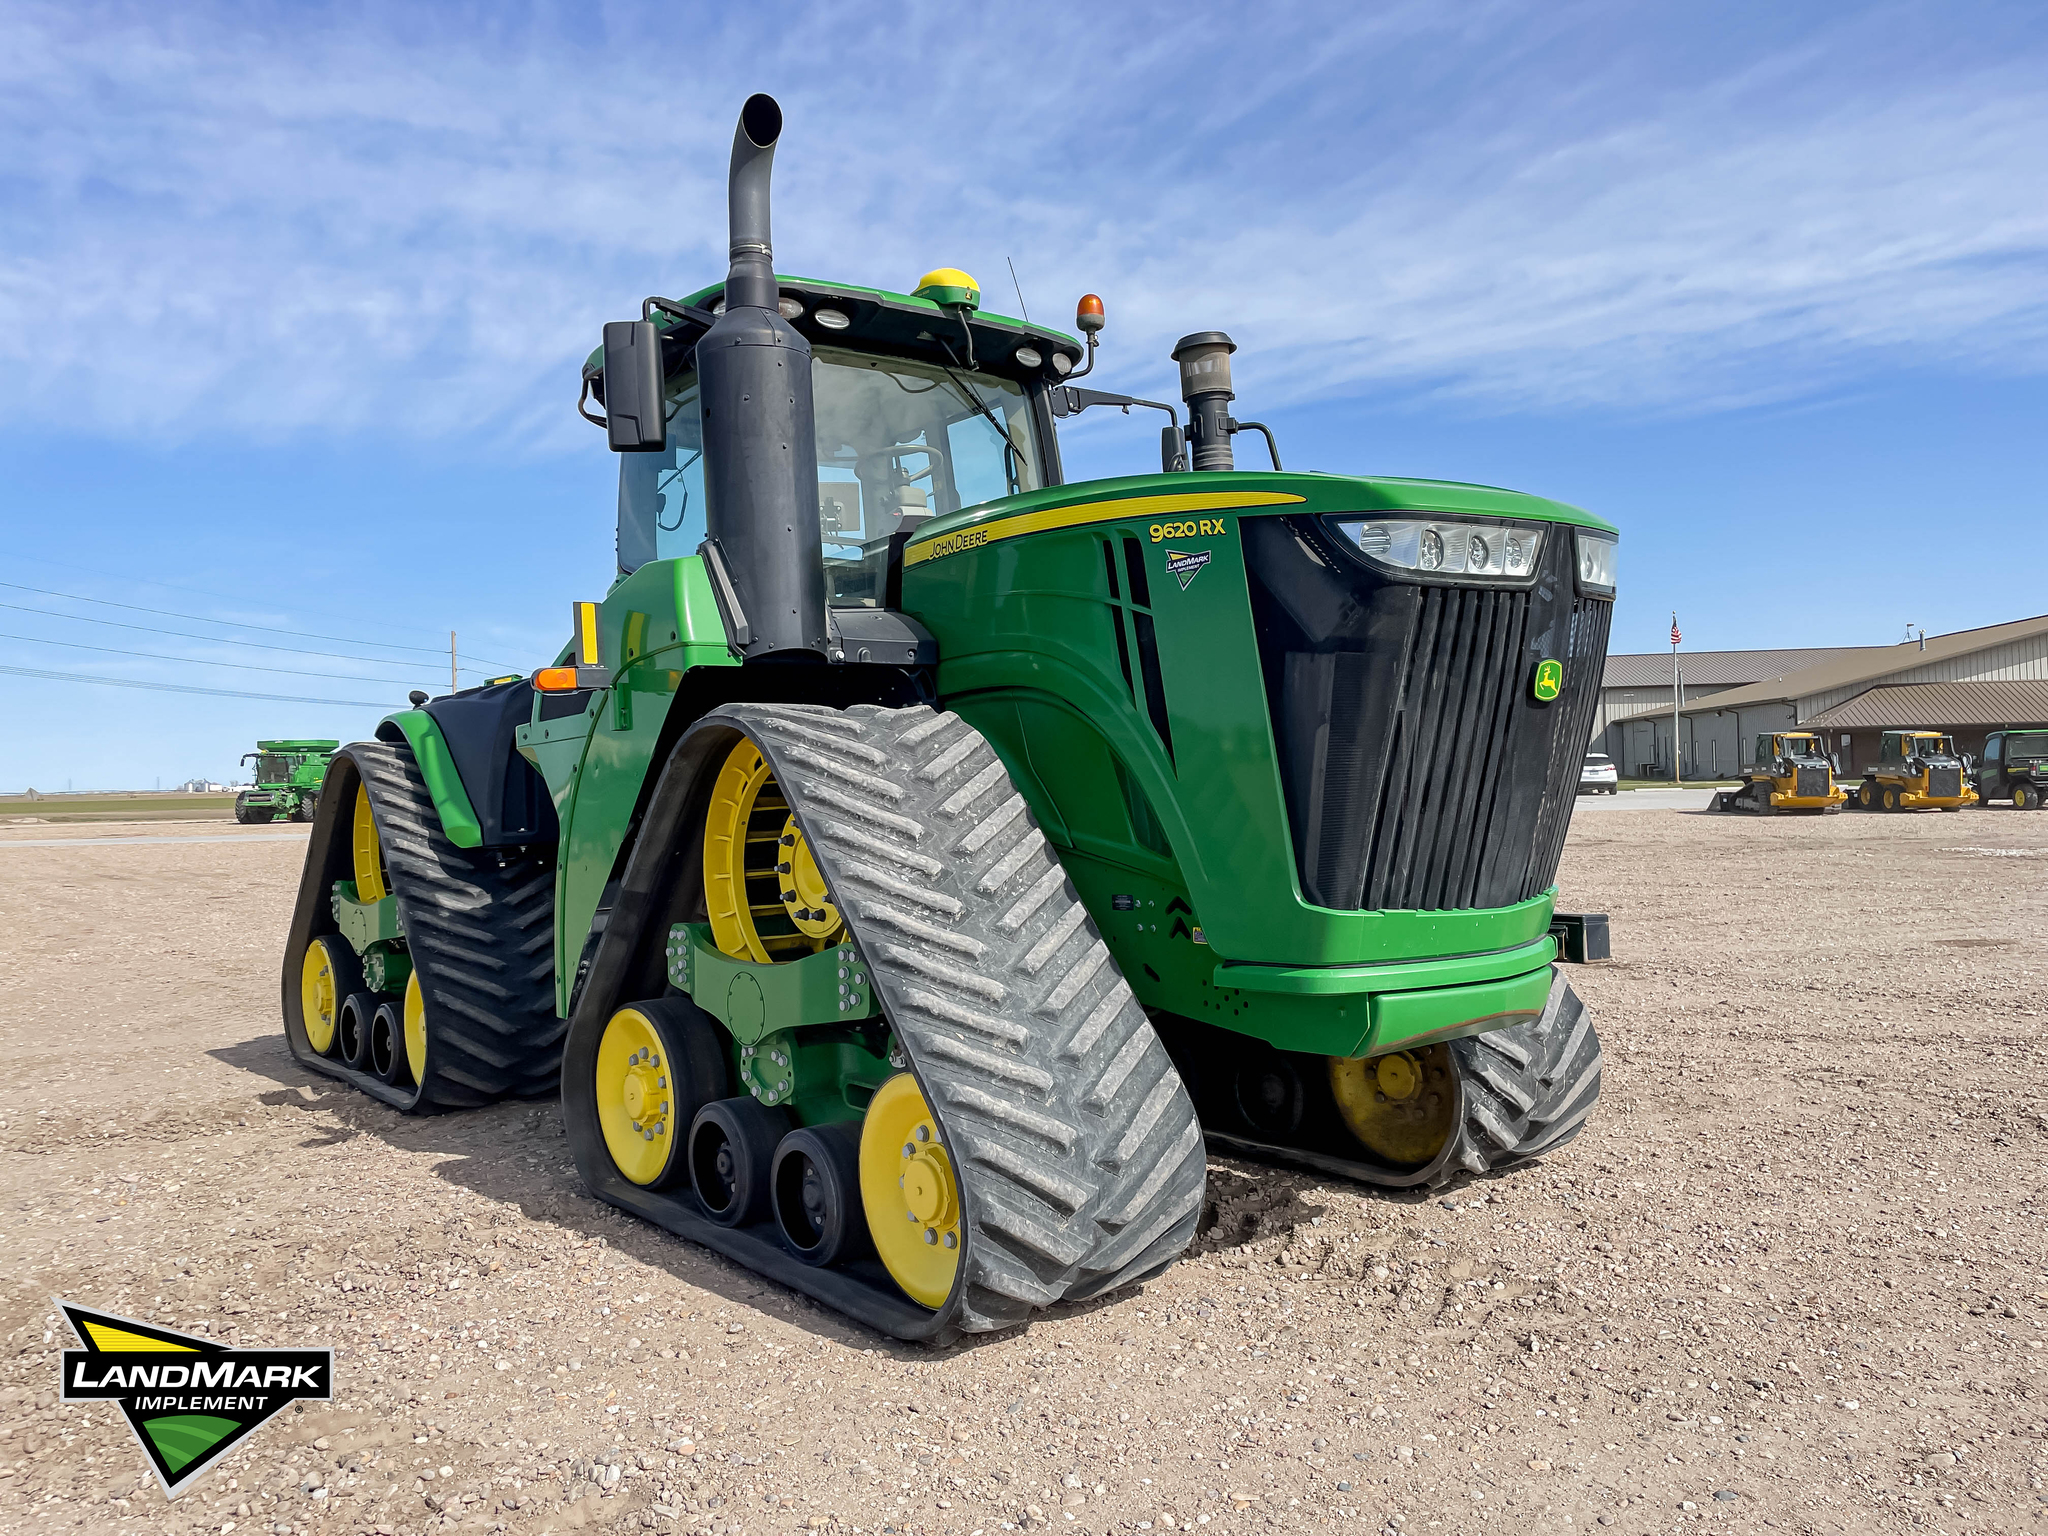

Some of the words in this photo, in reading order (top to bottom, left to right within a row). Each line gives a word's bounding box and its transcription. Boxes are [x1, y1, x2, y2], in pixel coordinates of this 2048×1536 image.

[929, 539, 955, 559] JOHN
[955, 529, 988, 551] DEERE
[1149, 520, 1197, 543] 9620
[1199, 518, 1226, 536] RX
